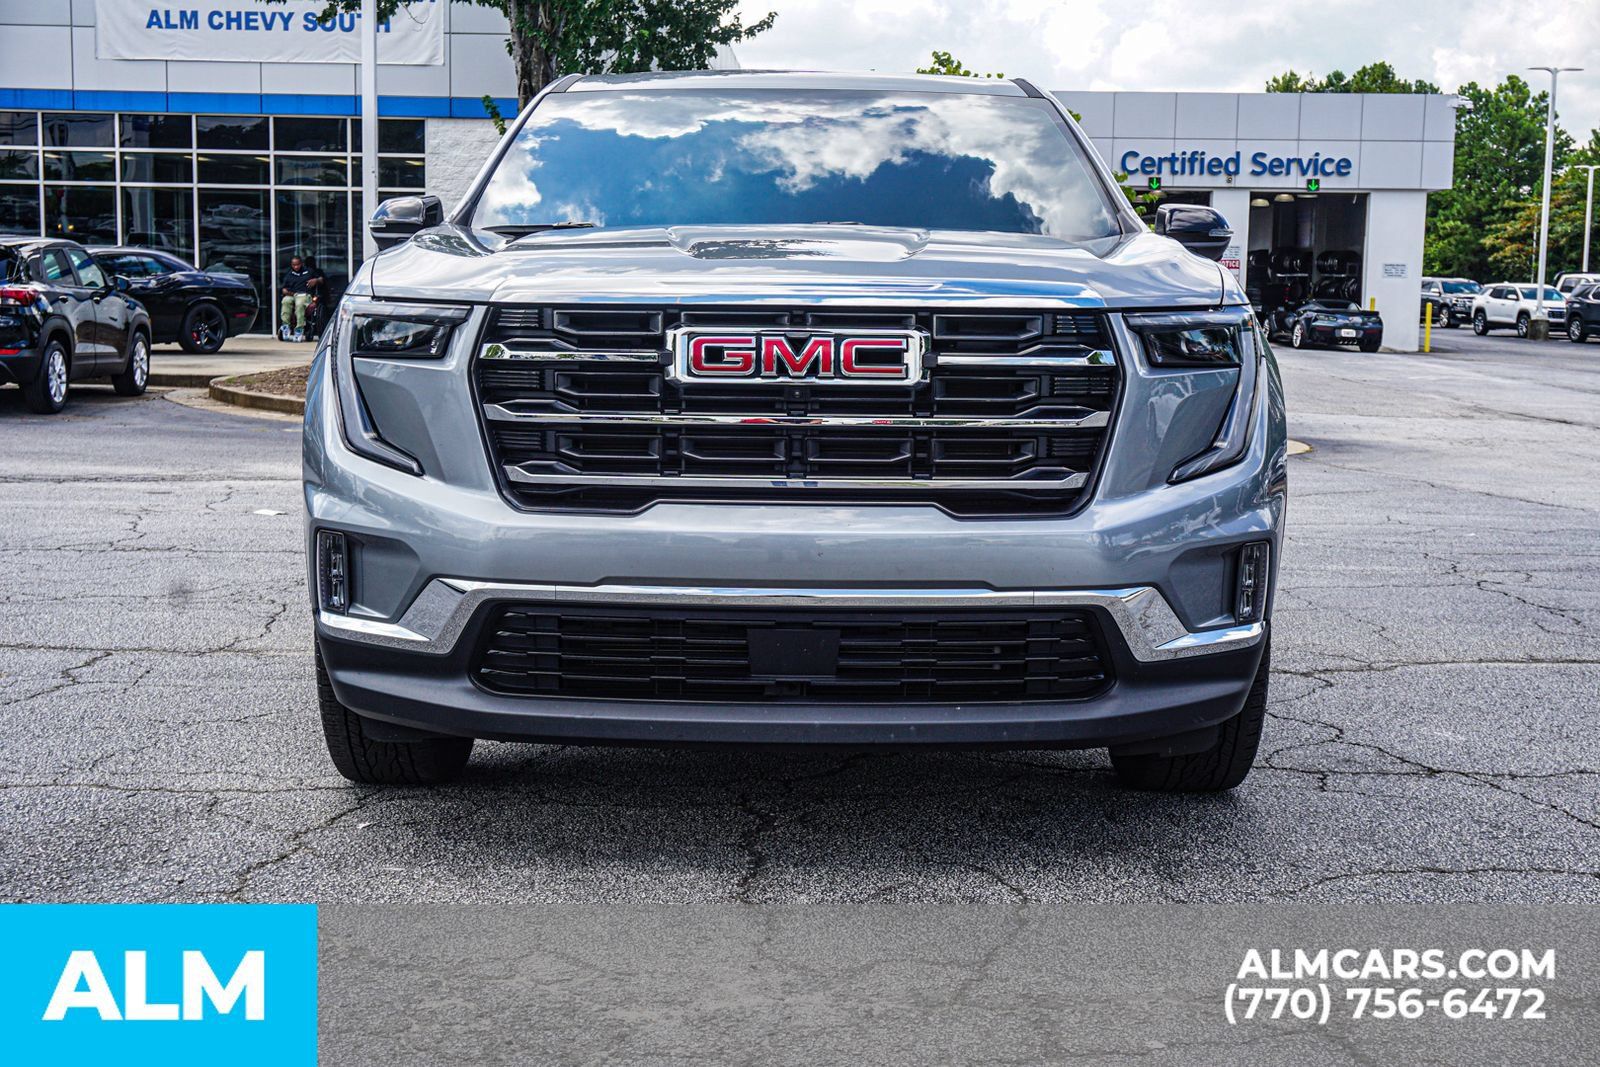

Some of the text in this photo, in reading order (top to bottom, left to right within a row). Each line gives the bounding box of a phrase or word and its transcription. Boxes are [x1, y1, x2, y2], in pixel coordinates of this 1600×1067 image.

[146, 9, 199, 30] ALM
[207, 10, 295, 32] CHEVY
[1120, 150, 1353, 177] Certified Service
[1218, 260, 1240, 268] OTICE
[689, 336, 908, 378] GMC
